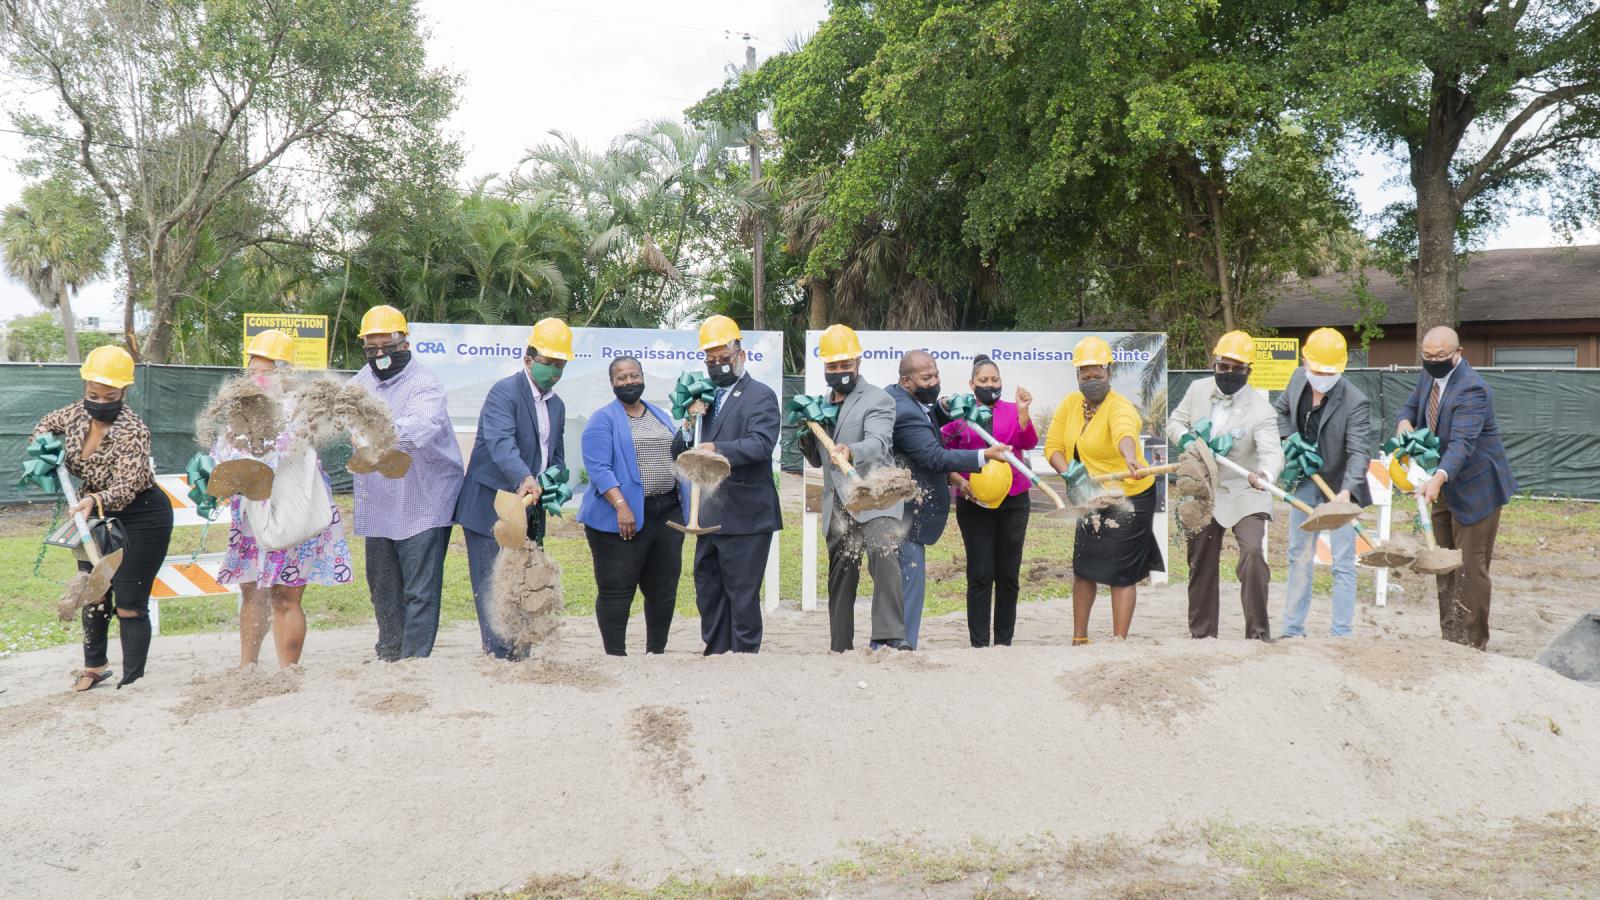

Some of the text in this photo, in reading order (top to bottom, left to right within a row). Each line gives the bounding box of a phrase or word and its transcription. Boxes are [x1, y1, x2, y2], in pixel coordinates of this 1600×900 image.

[248, 317, 323, 329] CONSTRUCTION
[416, 341, 446, 353] CRA
[456, 343, 522, 359] Coming
[601, 346, 706, 361] Renaissance
[860, 346, 1150, 361] omin oon... Renaissan ointe
[1256, 350, 1273, 360] REA
